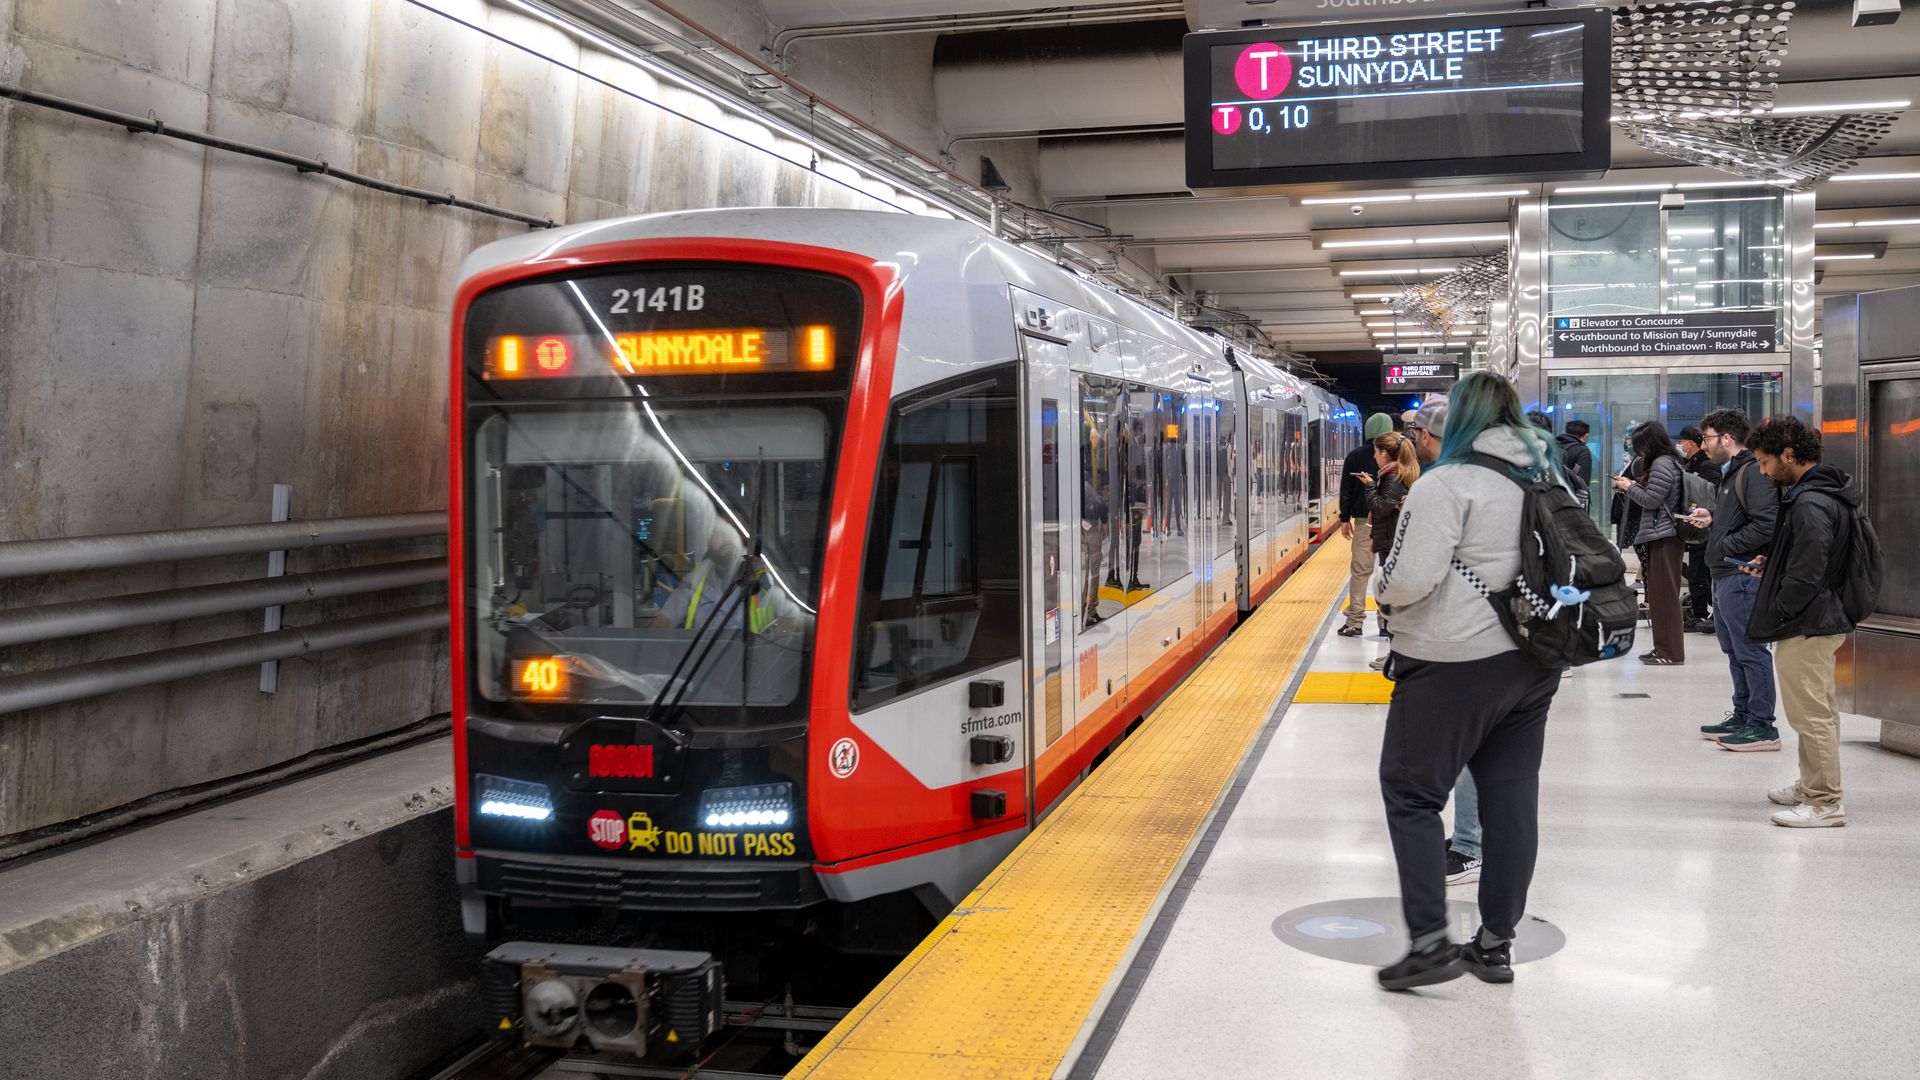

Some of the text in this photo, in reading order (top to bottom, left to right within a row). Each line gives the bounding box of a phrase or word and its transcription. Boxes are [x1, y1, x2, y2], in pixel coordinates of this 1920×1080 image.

[1298, 29, 1502, 62] THIRD STREET
[1249, 51, 1278, 90] T
[1298, 57, 1463, 88] SUNNYDALE
[1218, 105, 1309, 134] T 0, 10
[610, 285, 706, 314] 2141B
[1570, 331, 1627, 341] Southbound
[1630, 331, 1640, 339] to
[1643, 329, 1678, 339] Mission
[1681, 328, 1698, 340] Bay
[1707, 329, 1757, 340] Sunnydale
[1581, 317, 1684, 328] Elevator to Concourse
[614, 333, 762, 367] SUNNYDALE
[1581, 343, 1639, 353] Northbound
[1642, 343, 1651, 351] to
[1654, 341, 1706, 351] Chinatown
[1715, 341, 1736, 350] Rose
[1740, 340, 1758, 349] Pak
[523, 661, 558, 691] 40
[960, 711, 1021, 734] sfmta.com
[591, 817, 625, 843] STOP
[664, 831, 796, 856] DO NOT PASS
